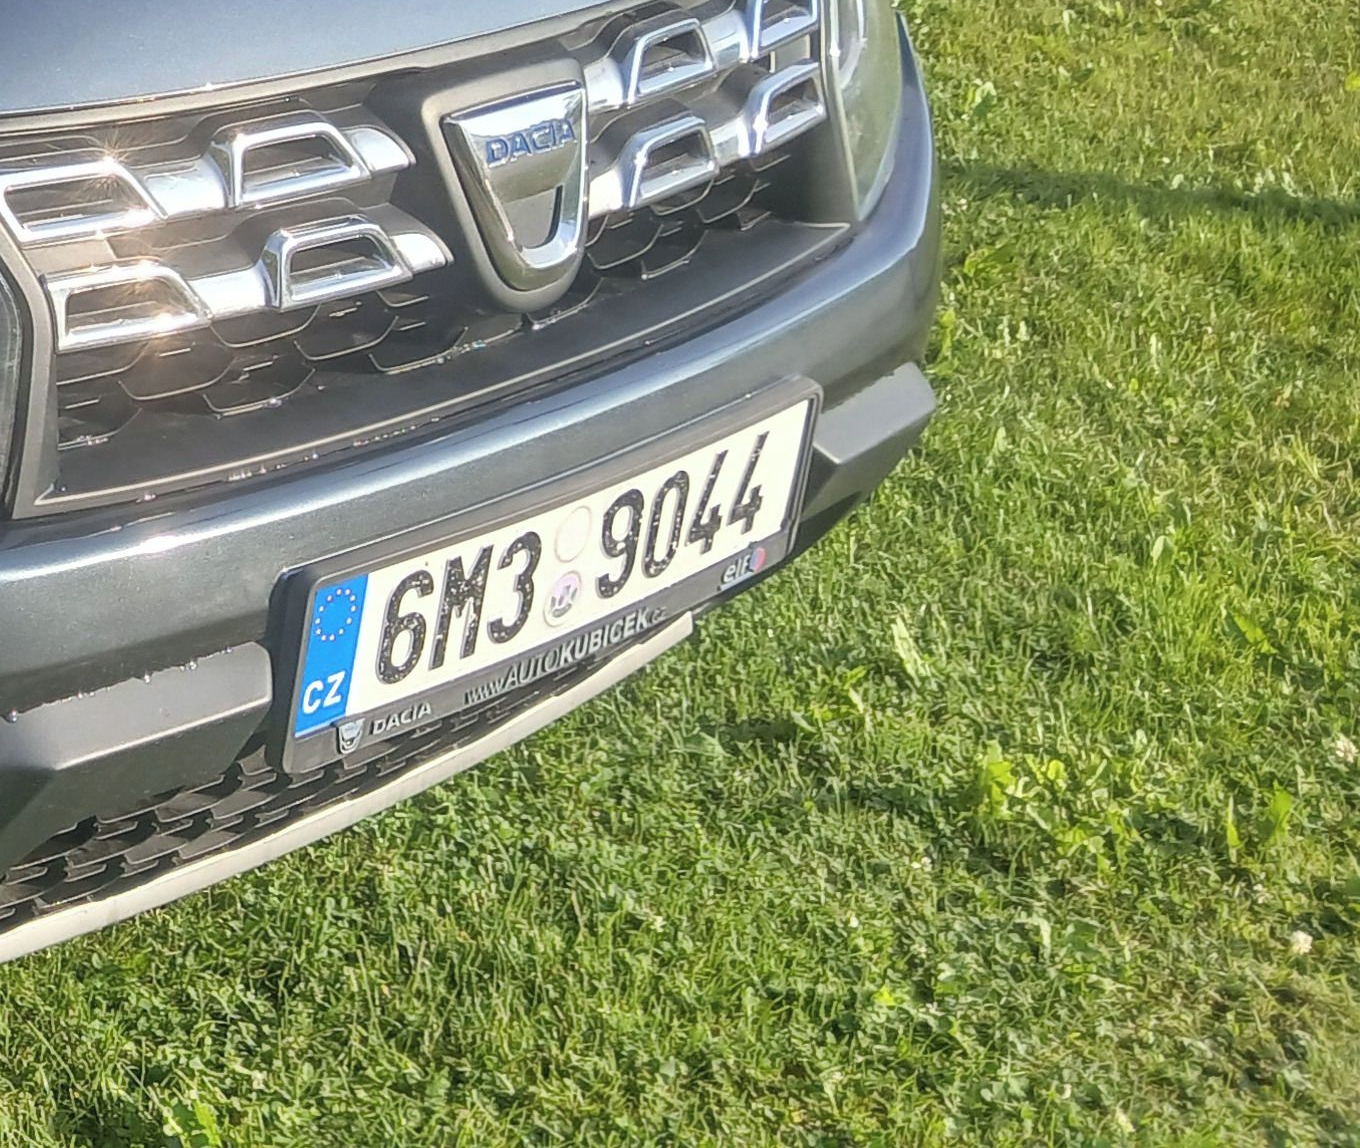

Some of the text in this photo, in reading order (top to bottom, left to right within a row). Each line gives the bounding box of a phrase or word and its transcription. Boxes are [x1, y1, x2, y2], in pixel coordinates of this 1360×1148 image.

[486, 119, 576, 168] DACIA
[375, 431, 770, 685] 6M3 9044
[302, 670, 346, 714] CZ
[371, 702, 432, 735] DACIA
